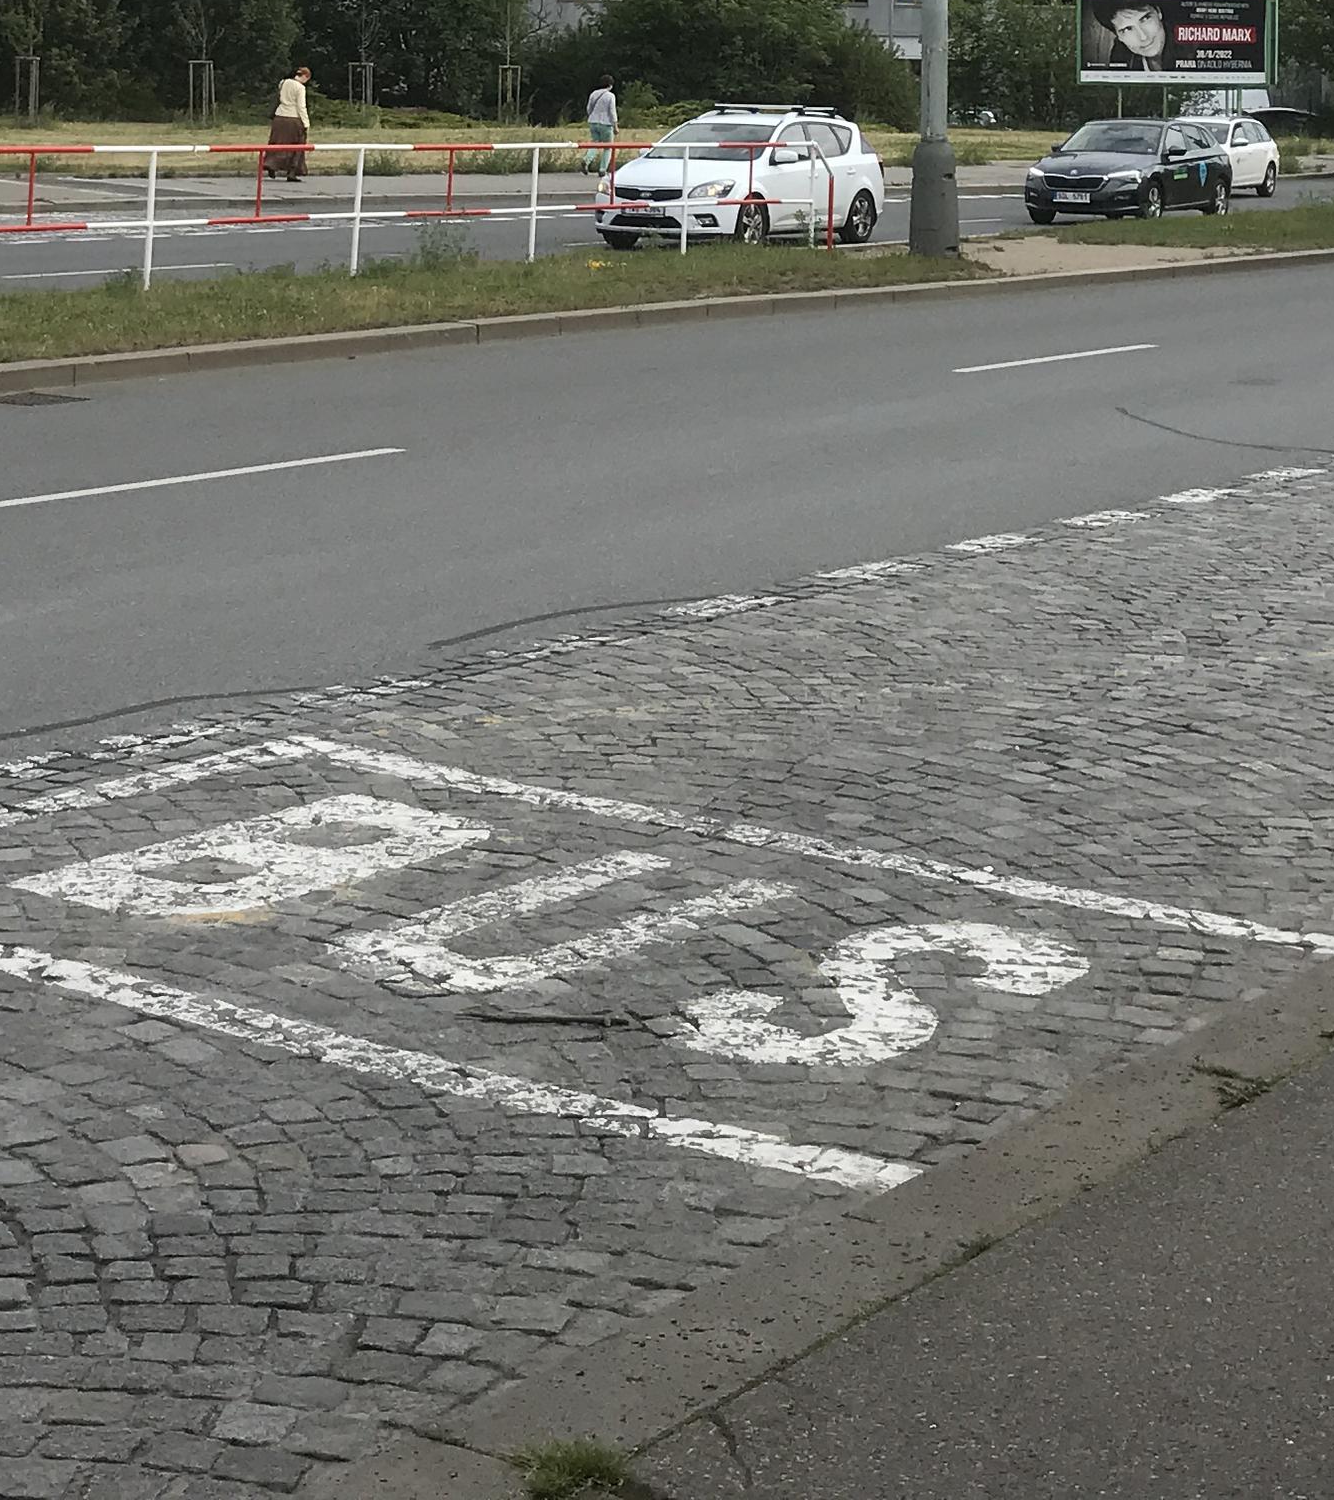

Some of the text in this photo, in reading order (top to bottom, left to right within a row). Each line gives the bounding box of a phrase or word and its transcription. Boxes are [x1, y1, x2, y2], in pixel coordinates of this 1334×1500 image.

[1178, 26, 1252, 42] RICHARD MARX
[7, 792, 1092, 1068] BUS
